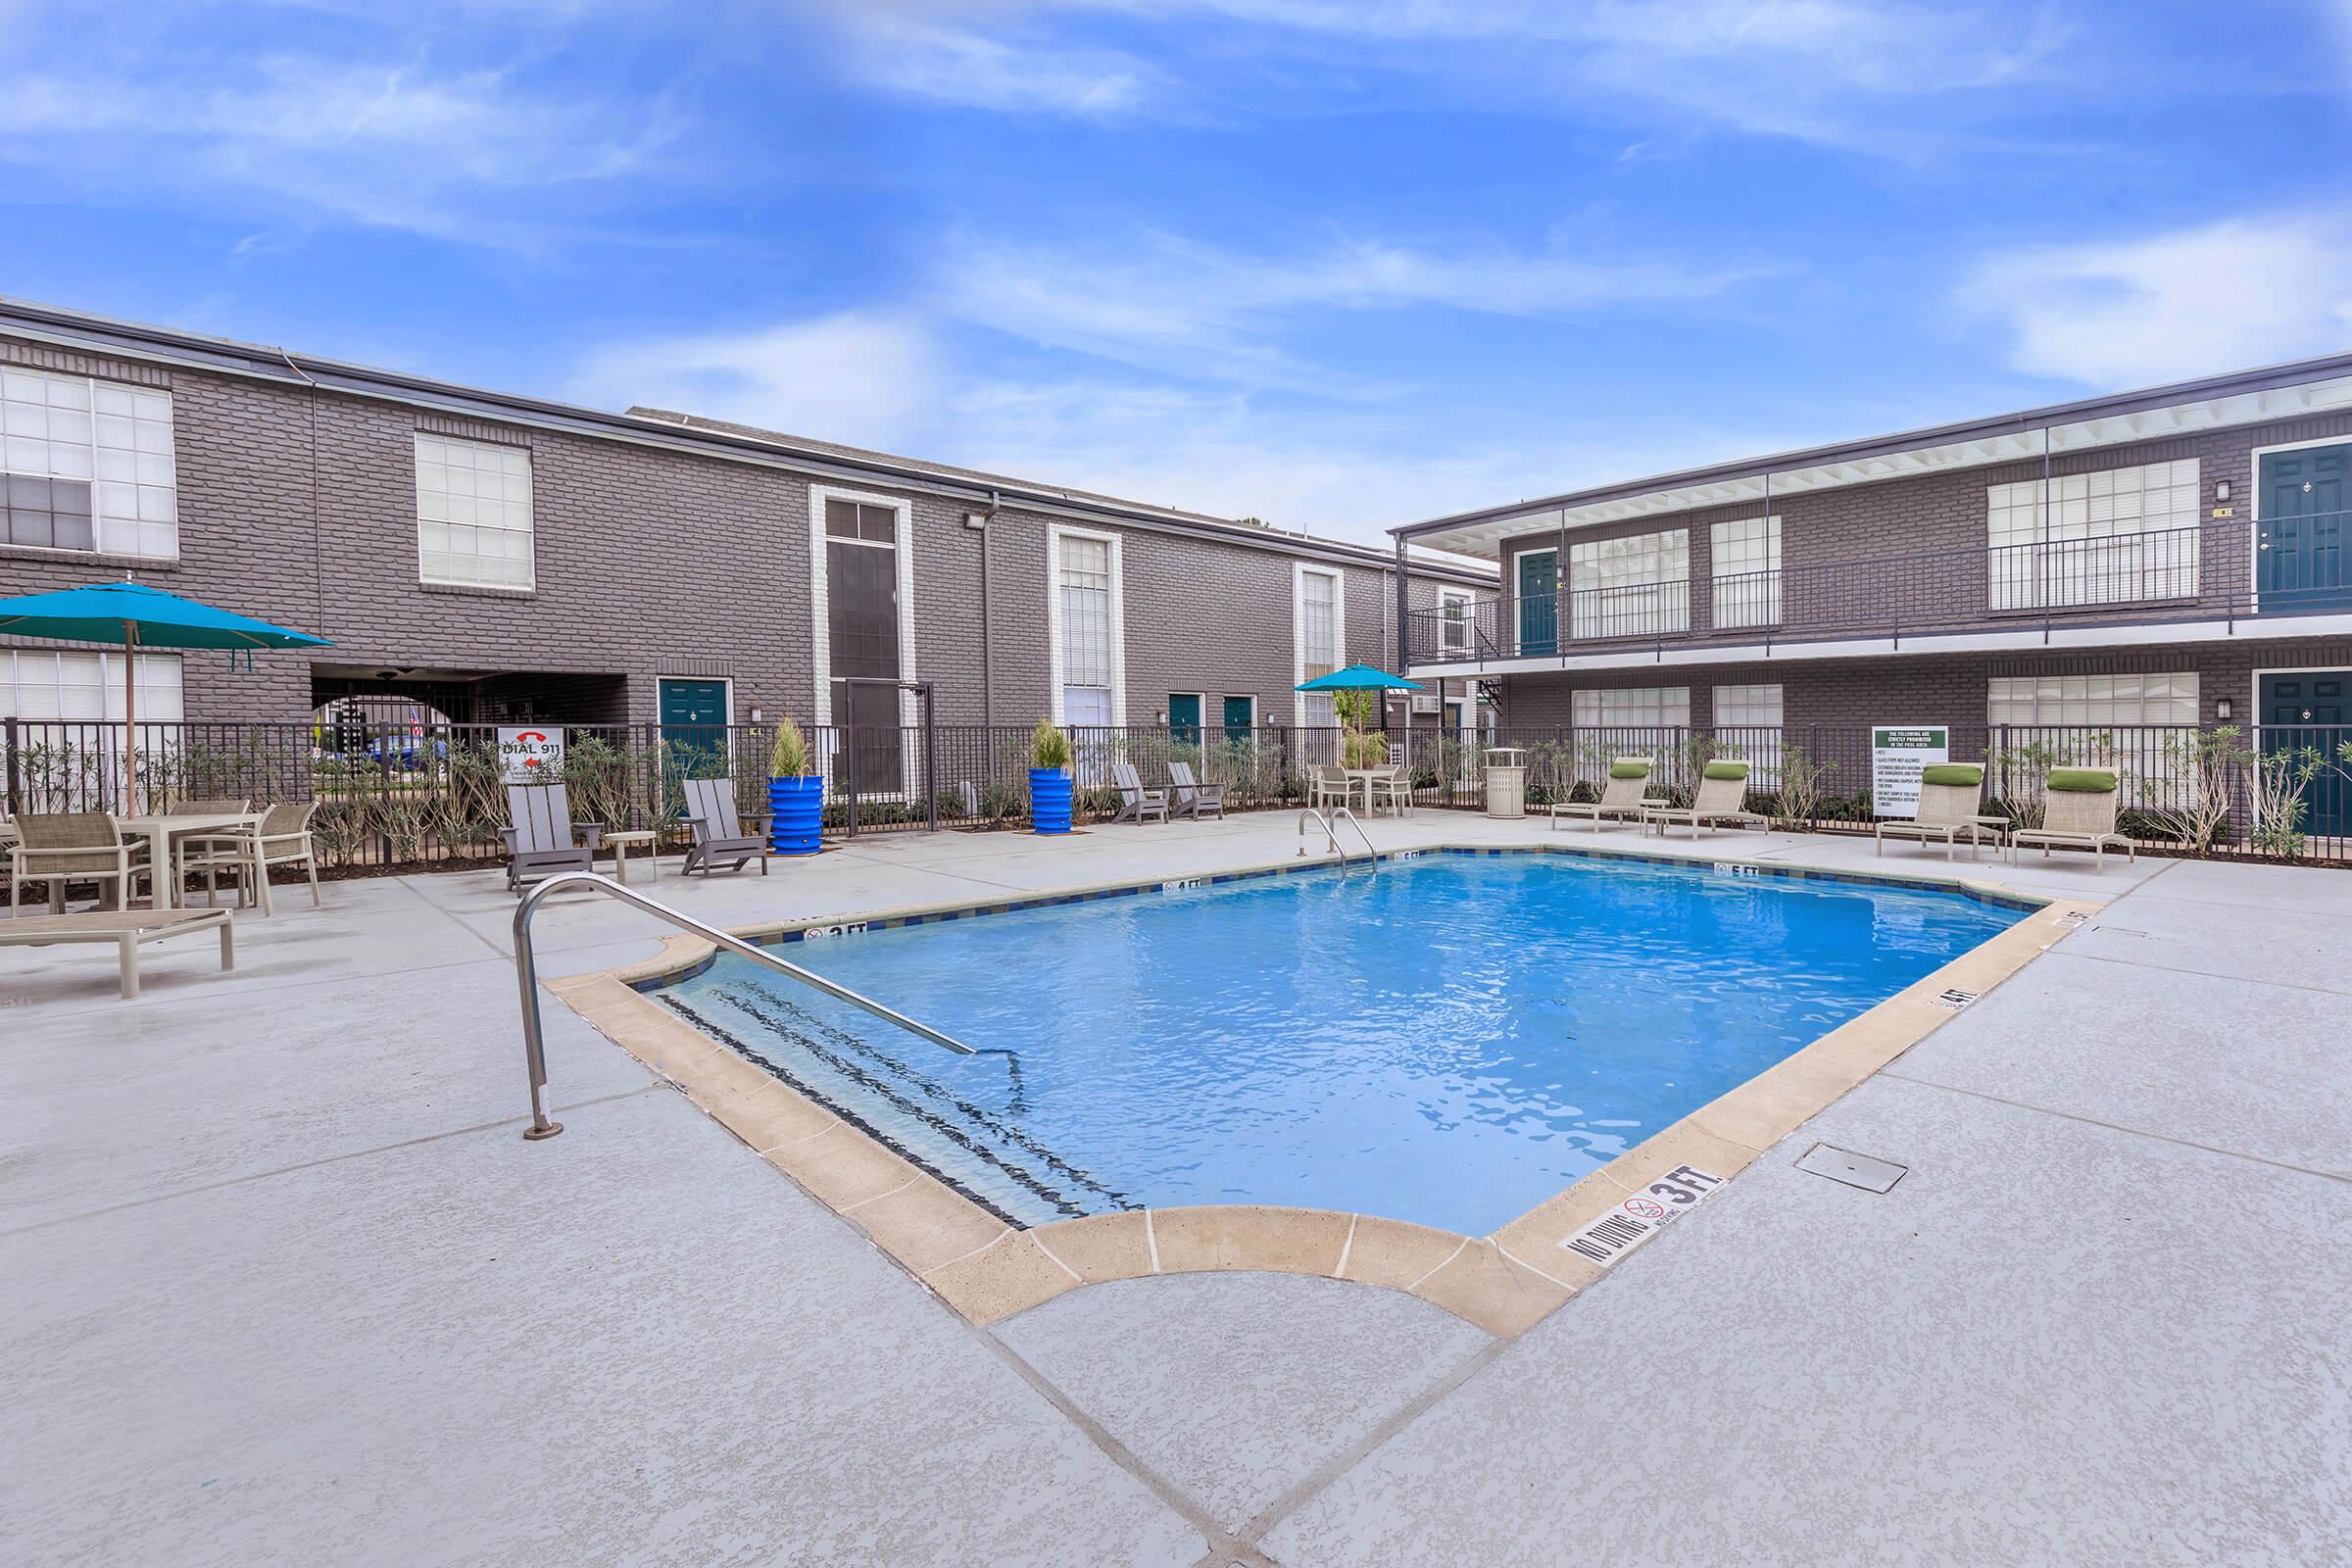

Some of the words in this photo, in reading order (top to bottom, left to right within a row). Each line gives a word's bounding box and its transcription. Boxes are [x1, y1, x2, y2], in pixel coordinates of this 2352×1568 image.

[503, 745, 537, 754] DIAL
[541, 745, 560, 754] 911
[1649, 1183, 1696, 1204] 3
[1586, 1214, 1649, 1249] DIVING
[1567, 1239, 1612, 1262] NO
